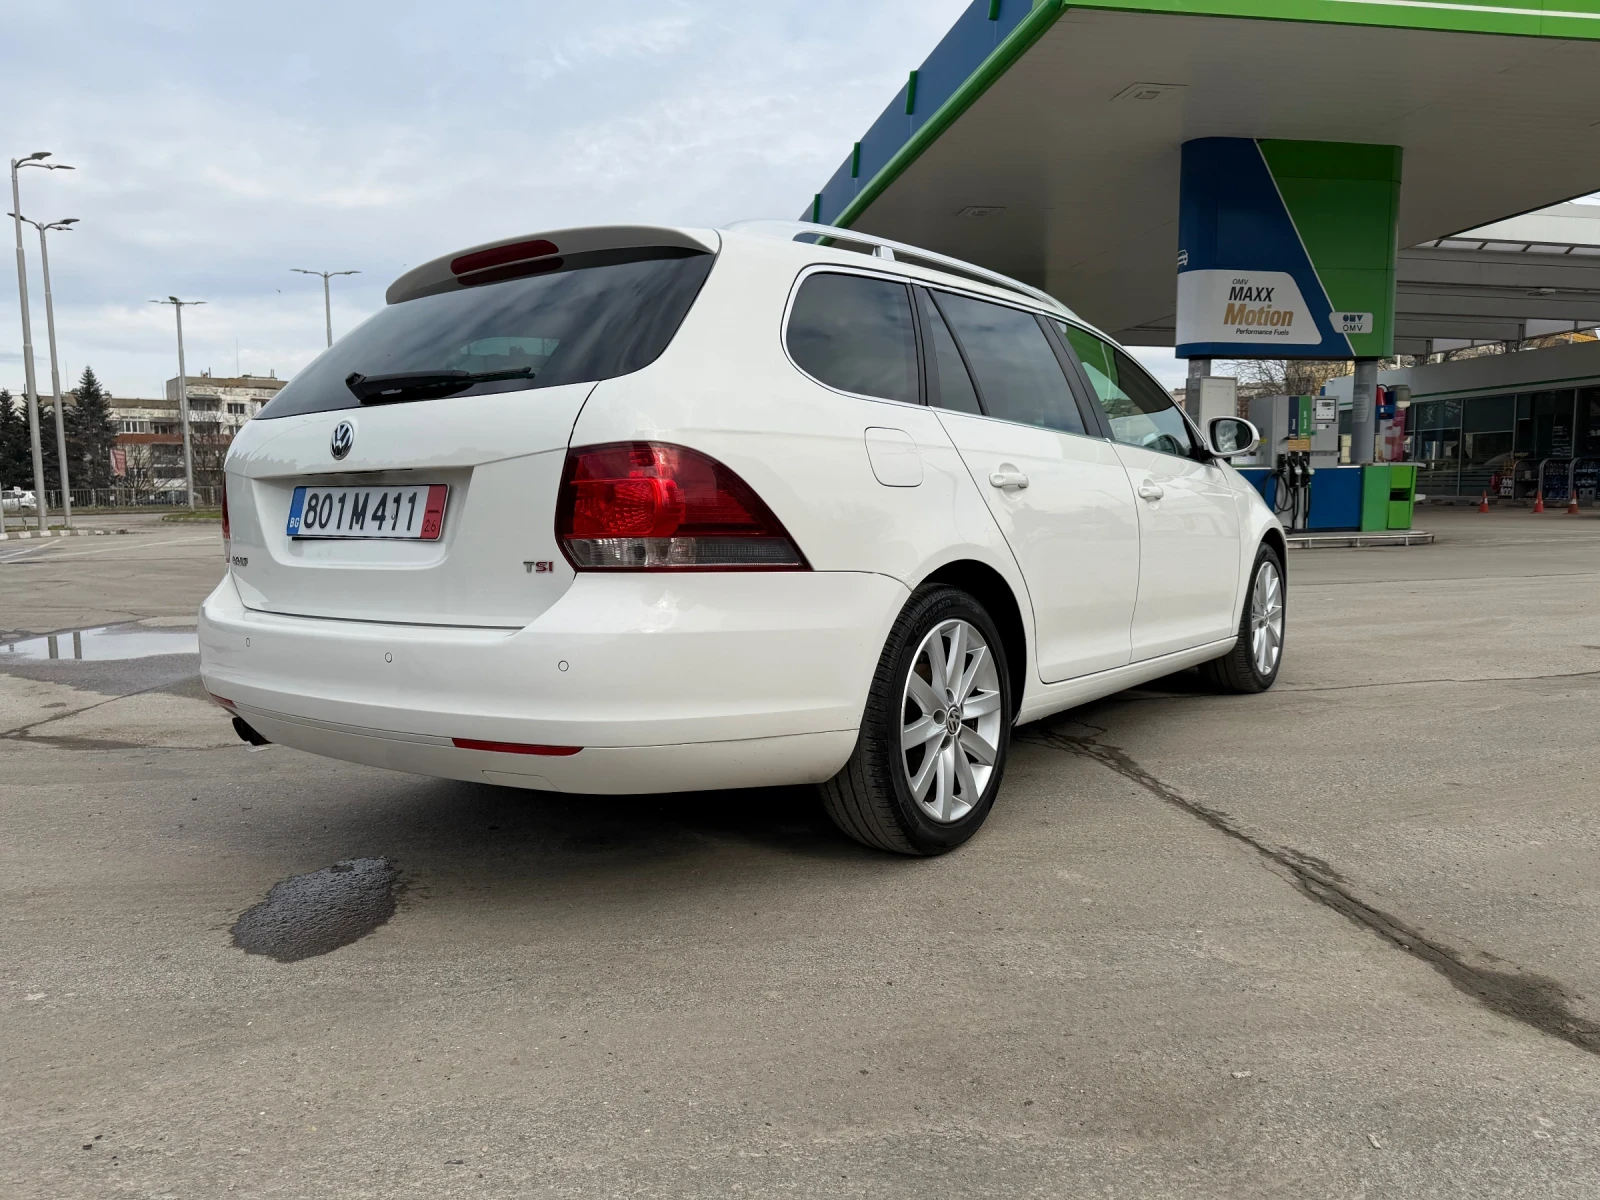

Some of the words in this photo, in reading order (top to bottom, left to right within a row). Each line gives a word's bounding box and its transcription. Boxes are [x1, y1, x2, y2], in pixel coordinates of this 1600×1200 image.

[1229, 286, 1275, 302] MAXX
[1223, 303, 1294, 327] Motion
[1236, 328, 1273, 336] Performance
[1342, 324, 1363, 332] OMV
[303, 492, 418, 531] 801M411
[289, 517, 300, 528] BG
[424, 519, 437, 532] 26
[522, 561, 554, 573] TSI
